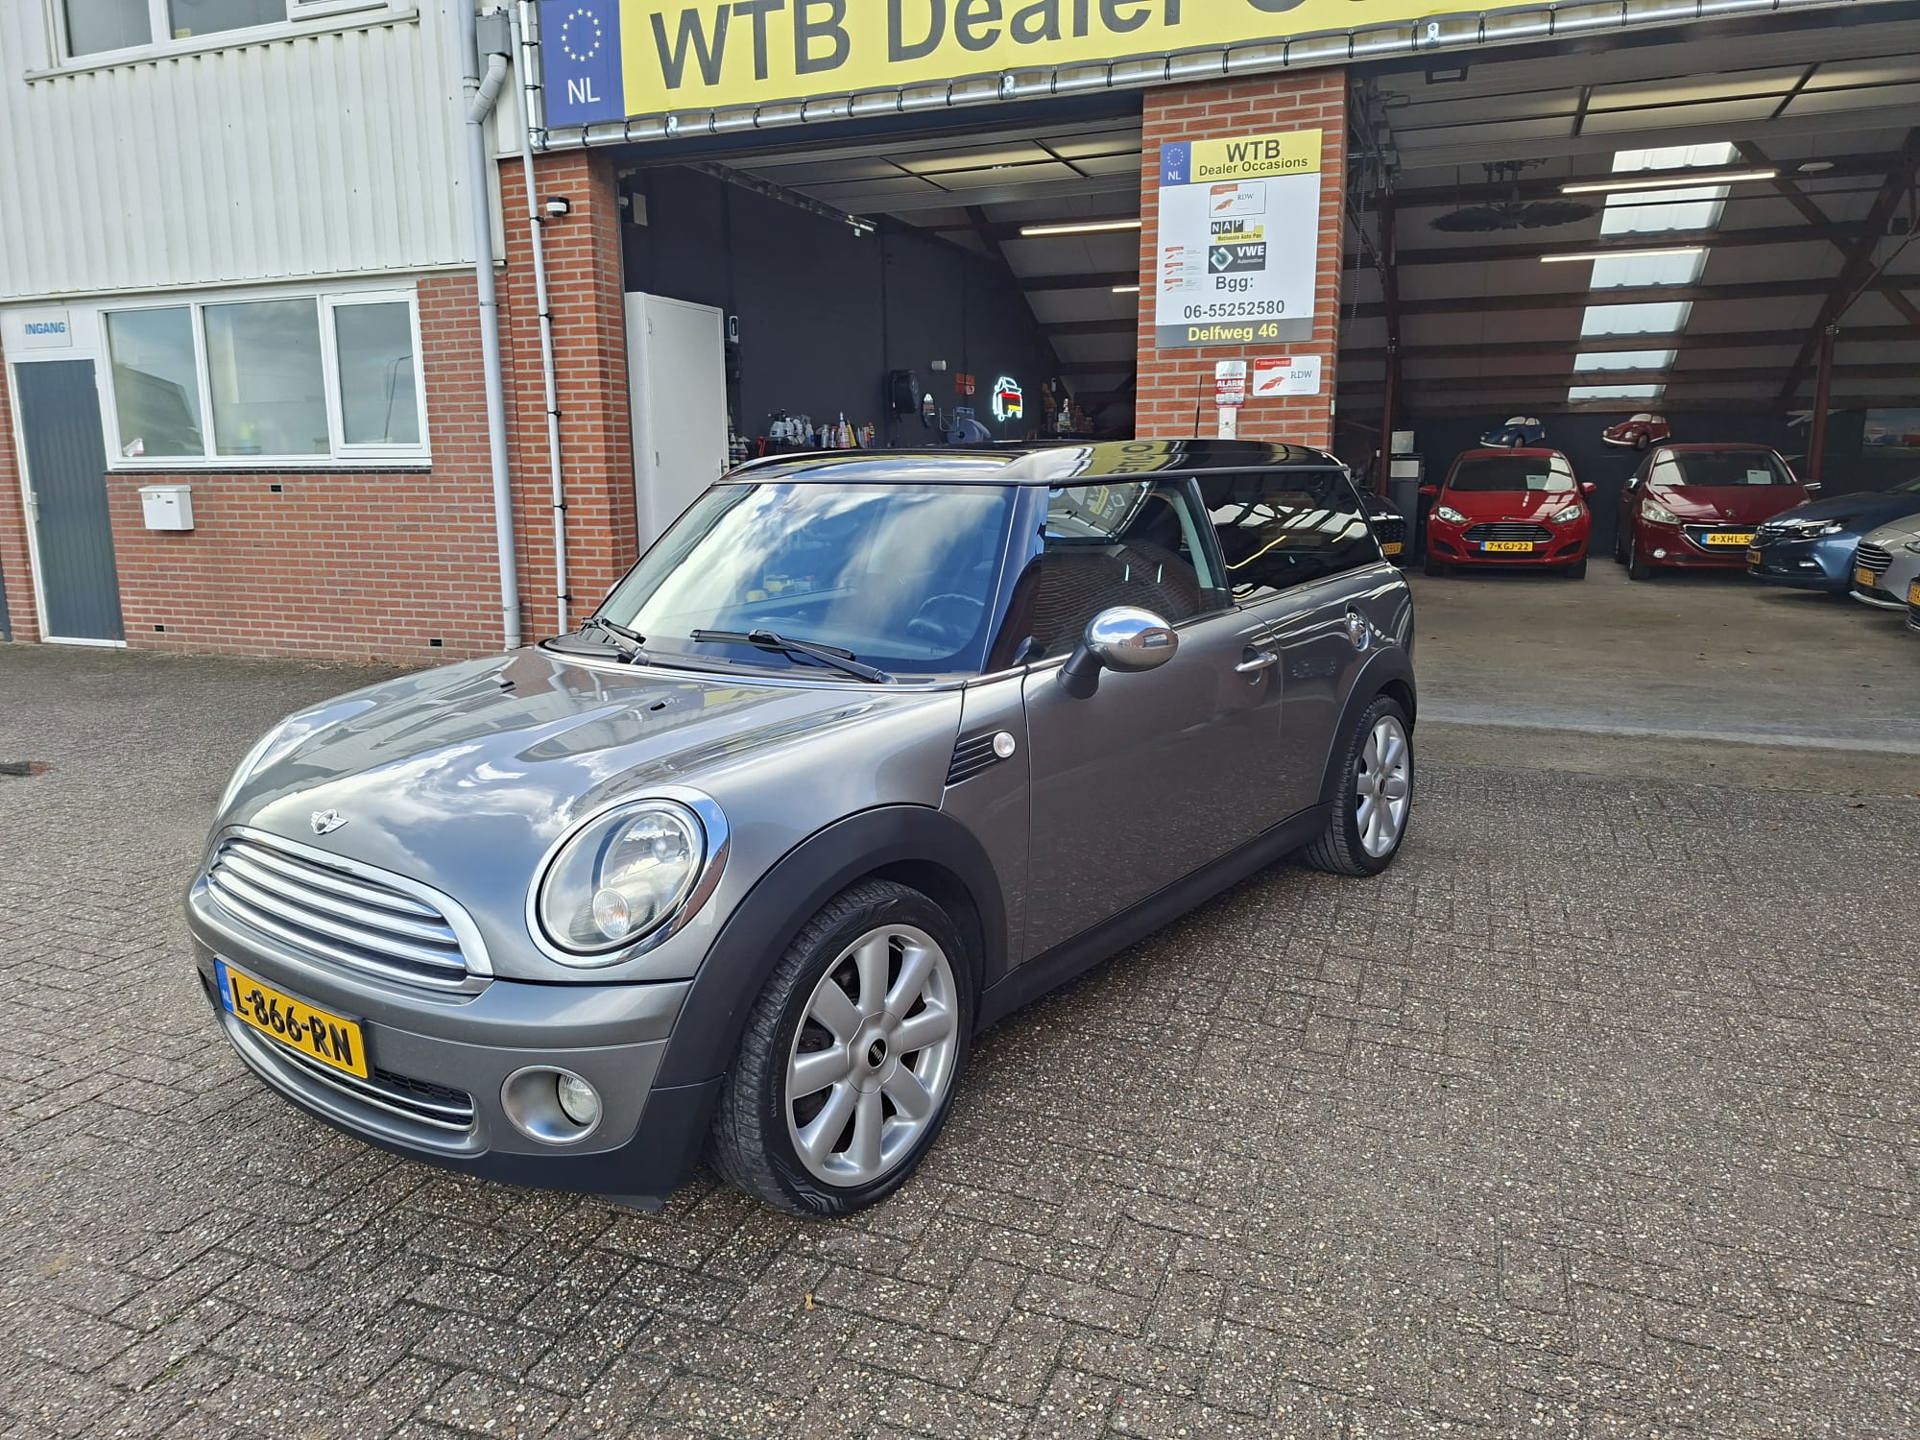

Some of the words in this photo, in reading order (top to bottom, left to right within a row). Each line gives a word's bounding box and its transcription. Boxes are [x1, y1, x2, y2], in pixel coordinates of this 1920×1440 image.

[650, 0, 851, 89] WTB
[568, 77, 601, 105] NL
[1226, 139, 1281, 163] WTB
[1199, 163, 1239, 176] Dealer
[1241, 157, 1308, 172] Occasions
[1167, 171, 1182, 181] NL
[1211, 220, 1243, 233] NAP
[1236, 244, 1265, 257] VWE
[1215, 276, 1254, 292] Bgg:
[1184, 300, 1285, 319] 06-55252580
[25, 322, 65, 335] INGANG
[1188, 326, 1254, 341] Delfweg
[1258, 323, 1278, 338] 46
[1290, 370, 1313, 379] RDW
[1489, 542, 1529, 550] 7-KGJ-22
[1710, 535, 1753, 543] 4-XHL-5
[231, 976, 354, 1066] L-866-RN
